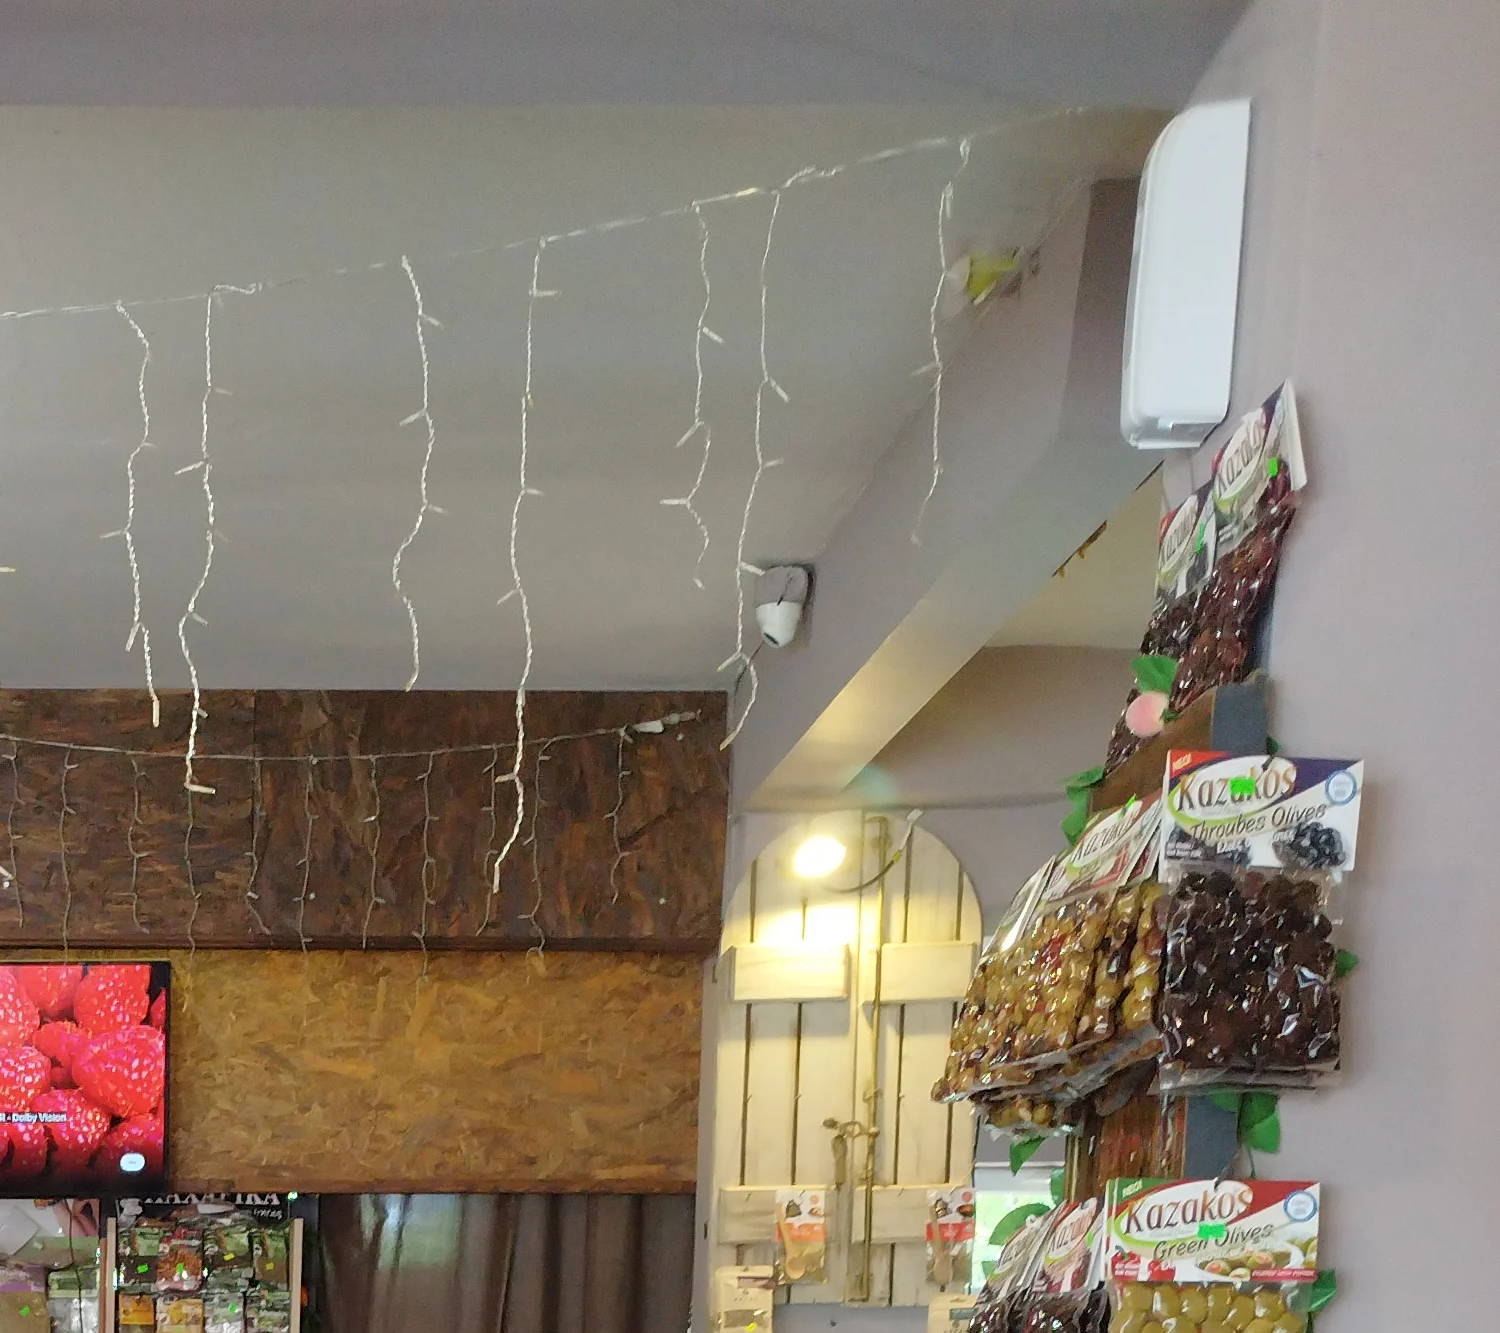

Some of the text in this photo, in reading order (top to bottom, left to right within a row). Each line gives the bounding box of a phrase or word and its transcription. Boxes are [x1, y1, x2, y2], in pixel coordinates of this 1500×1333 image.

[1190, 803, 1327, 841] Throubes Olives
[1124, 1188, 1252, 1235] Kazakos
[1153, 1236, 1209, 1261] Green
